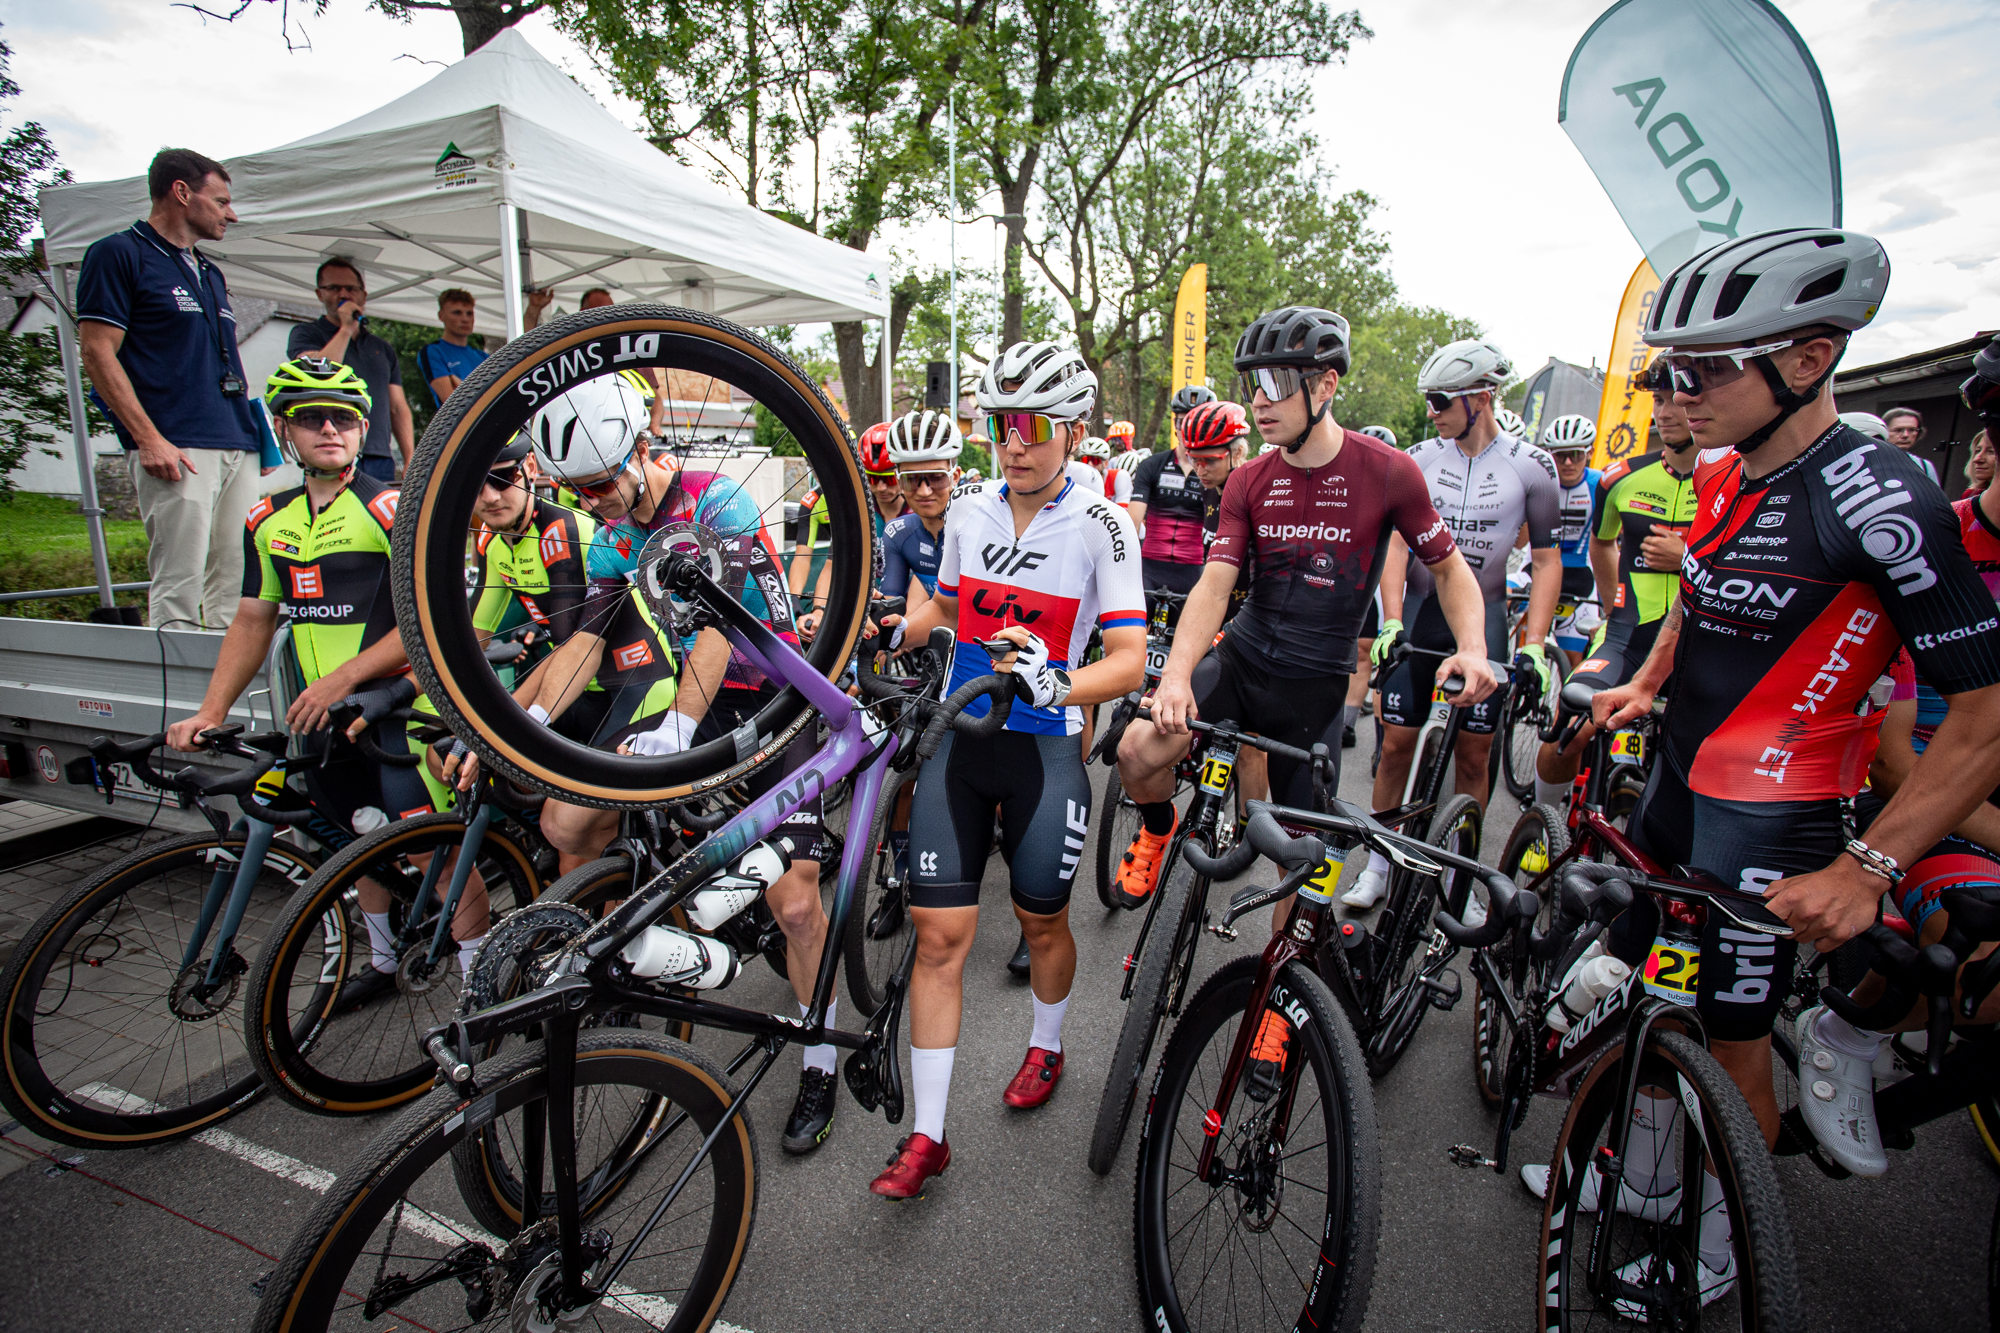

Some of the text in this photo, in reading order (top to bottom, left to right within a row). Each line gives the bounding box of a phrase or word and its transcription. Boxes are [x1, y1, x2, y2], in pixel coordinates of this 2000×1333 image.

[517, 333, 661, 407] DT SWISS
[1528, 450, 1557, 480] LAZER
[1257, 521, 1351, 543] superior.
[1759, 515, 1782, 525] 100%
[1820, 443, 1939, 597] brilon
[1454, 536, 1494, 551] erior.
[1738, 535, 1788, 547] challenge
[981, 543, 1049, 577] VIF
[1724, 551, 1788, 562] ALPINE PRO
[1681, 545, 1799, 609] RILON
[299, 604, 354, 617] GROUP
[1696, 593, 1779, 621] TEAM MB
[1699, 621, 1739, 636] BLACK
[1147, 651, 1166, 669] 10
[1791, 607, 1880, 716] BLACK
[794, 708, 814, 730] GRAVEL
[764, 727, 797, 756] THUNDERO
[39, 750, 57, 774] 100
[1204, 760, 1230, 789] 13
[1305, 859, 1332, 893] 2
[1654, 950, 1700, 992] 22
[1284, 998, 1310, 1031] DT
[1558, 964, 1641, 1060] RIDLEY
[379, 1110, 457, 1177] GRAVEL THUNDERO
[1315, 1264, 1324, 1285] 1100
